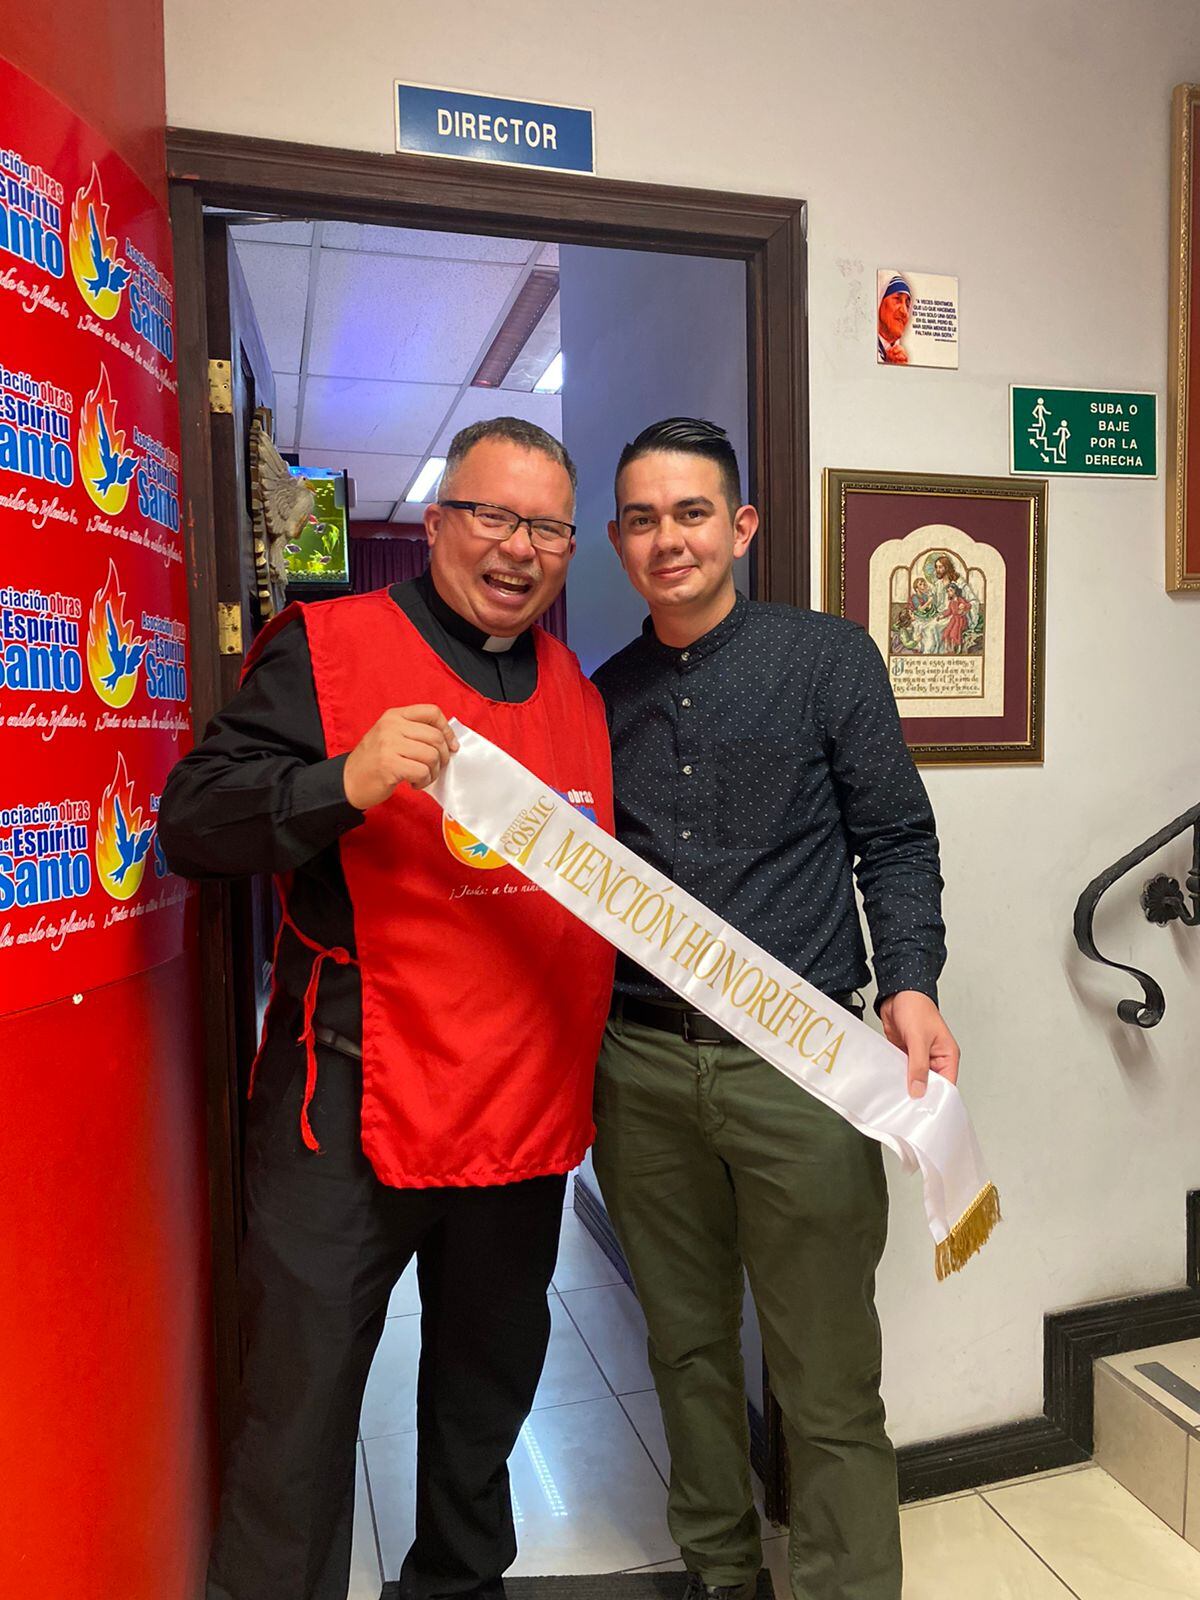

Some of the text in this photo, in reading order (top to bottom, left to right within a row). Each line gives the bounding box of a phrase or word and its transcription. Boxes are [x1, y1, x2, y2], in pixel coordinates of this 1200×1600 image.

[437, 108, 557, 150] DIRECTOR
[0, 150, 64, 204] ción obras
[129, 282, 174, 363] Santo
[40, 381, 73, 413] obras
[1090, 402, 1138, 415] SUBA O
[133, 425, 165, 461] Asociación
[1090, 437, 1138, 449] POR LA
[1098, 420, 1130, 432] BAJE
[146, 452, 178, 495] Espíritu
[1085, 454, 1143, 466] DERECHA
[137, 468, 180, 533] Santo
[49, 592, 82, 618] obras
[2, 608, 79, 647] Espíritu
[141, 611, 173, 636] Asociación
[0, 637, 83, 694] anto
[154, 633, 185, 664] Espíritu
[145, 652, 187, 702] Santo
[0, 799, 91, 828] ociación obras
[568, 789, 594, 804] obras
[12, 823, 88, 859] Espíritu
[500, 808, 528, 844] INSTITUTO
[503, 795, 555, 857] COSVIC
[0, 851, 92, 912] Santo
[449, 885, 488, 901] ¡Jesús:
[492, 886, 500, 895] a
[504, 883, 518, 894] tus
[544, 828, 846, 1075] MENCIÓN HONORÍFICA
